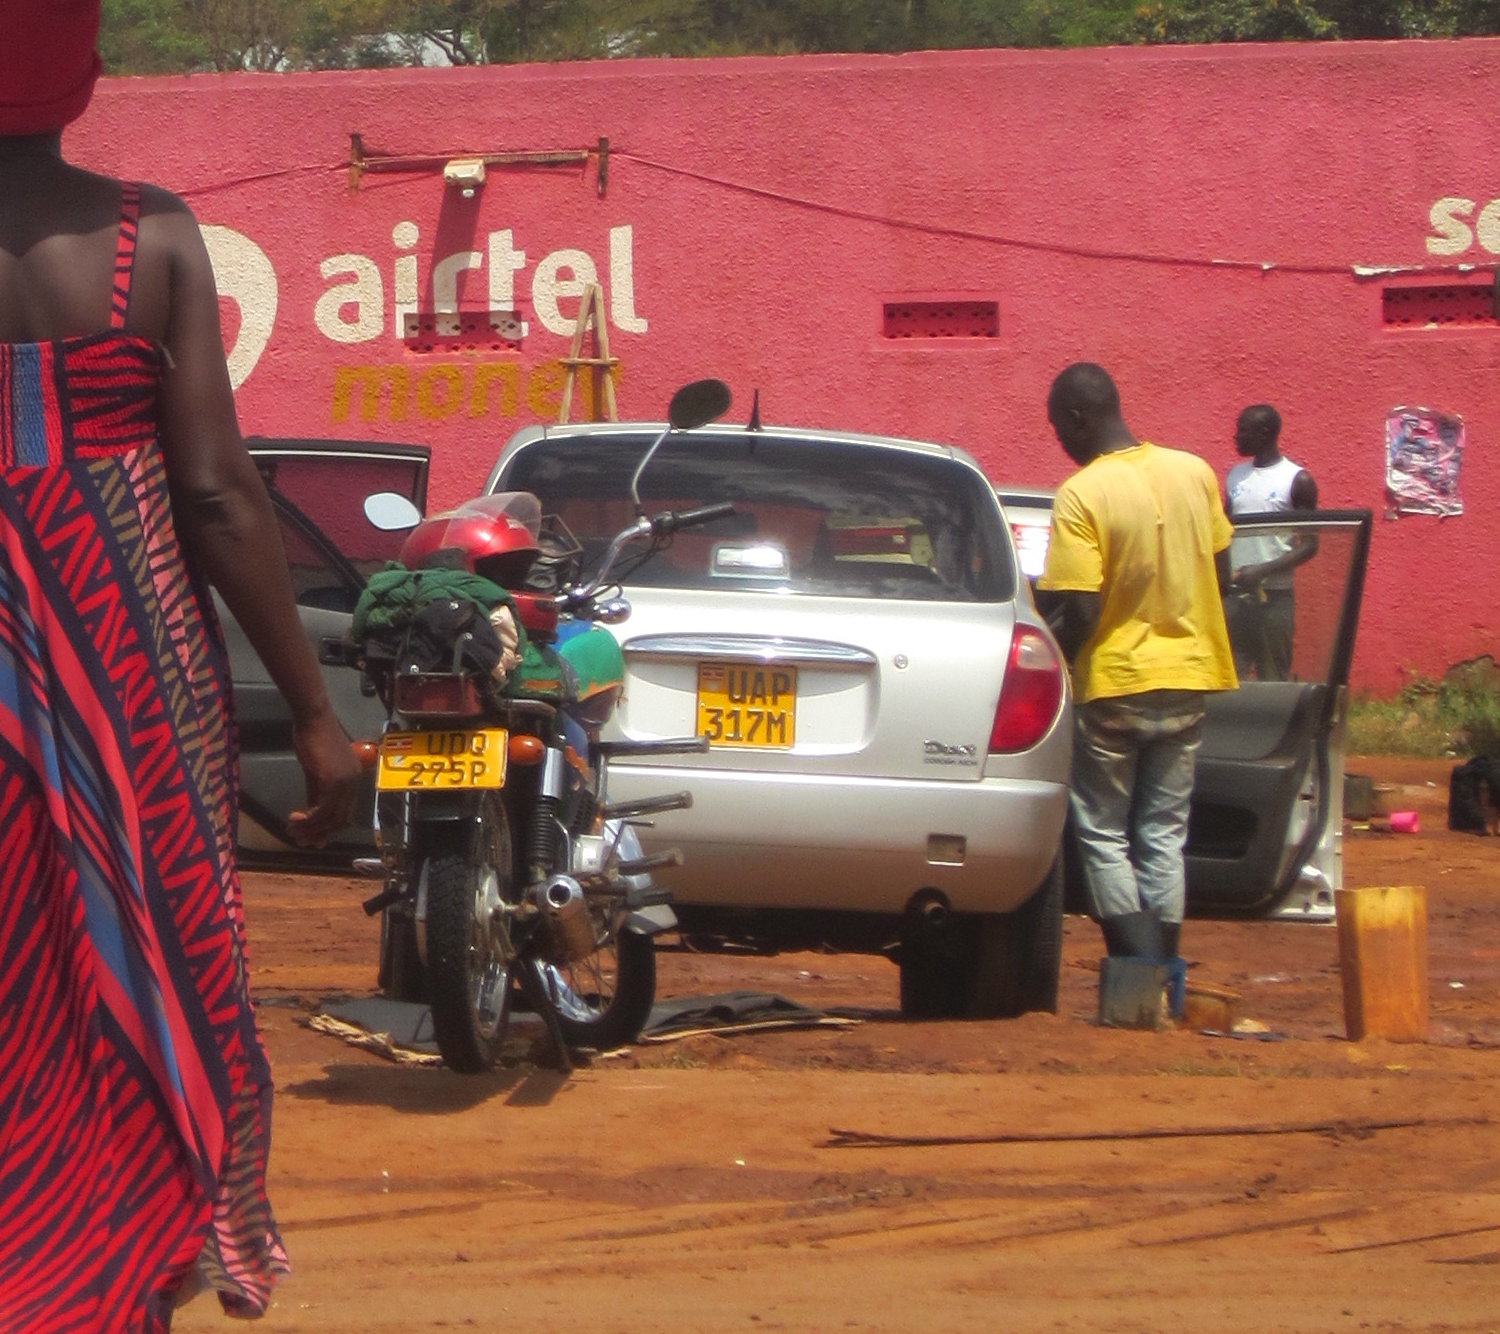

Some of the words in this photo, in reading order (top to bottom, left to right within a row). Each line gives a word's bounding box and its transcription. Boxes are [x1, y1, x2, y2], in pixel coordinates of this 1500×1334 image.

[313, 221, 648, 344] airtel
[728, 670, 790, 705] UAP
[705, 708, 786, 743] 317M
[428, 733, 486, 756] UDQ
[409, 761, 486, 785] 275P
